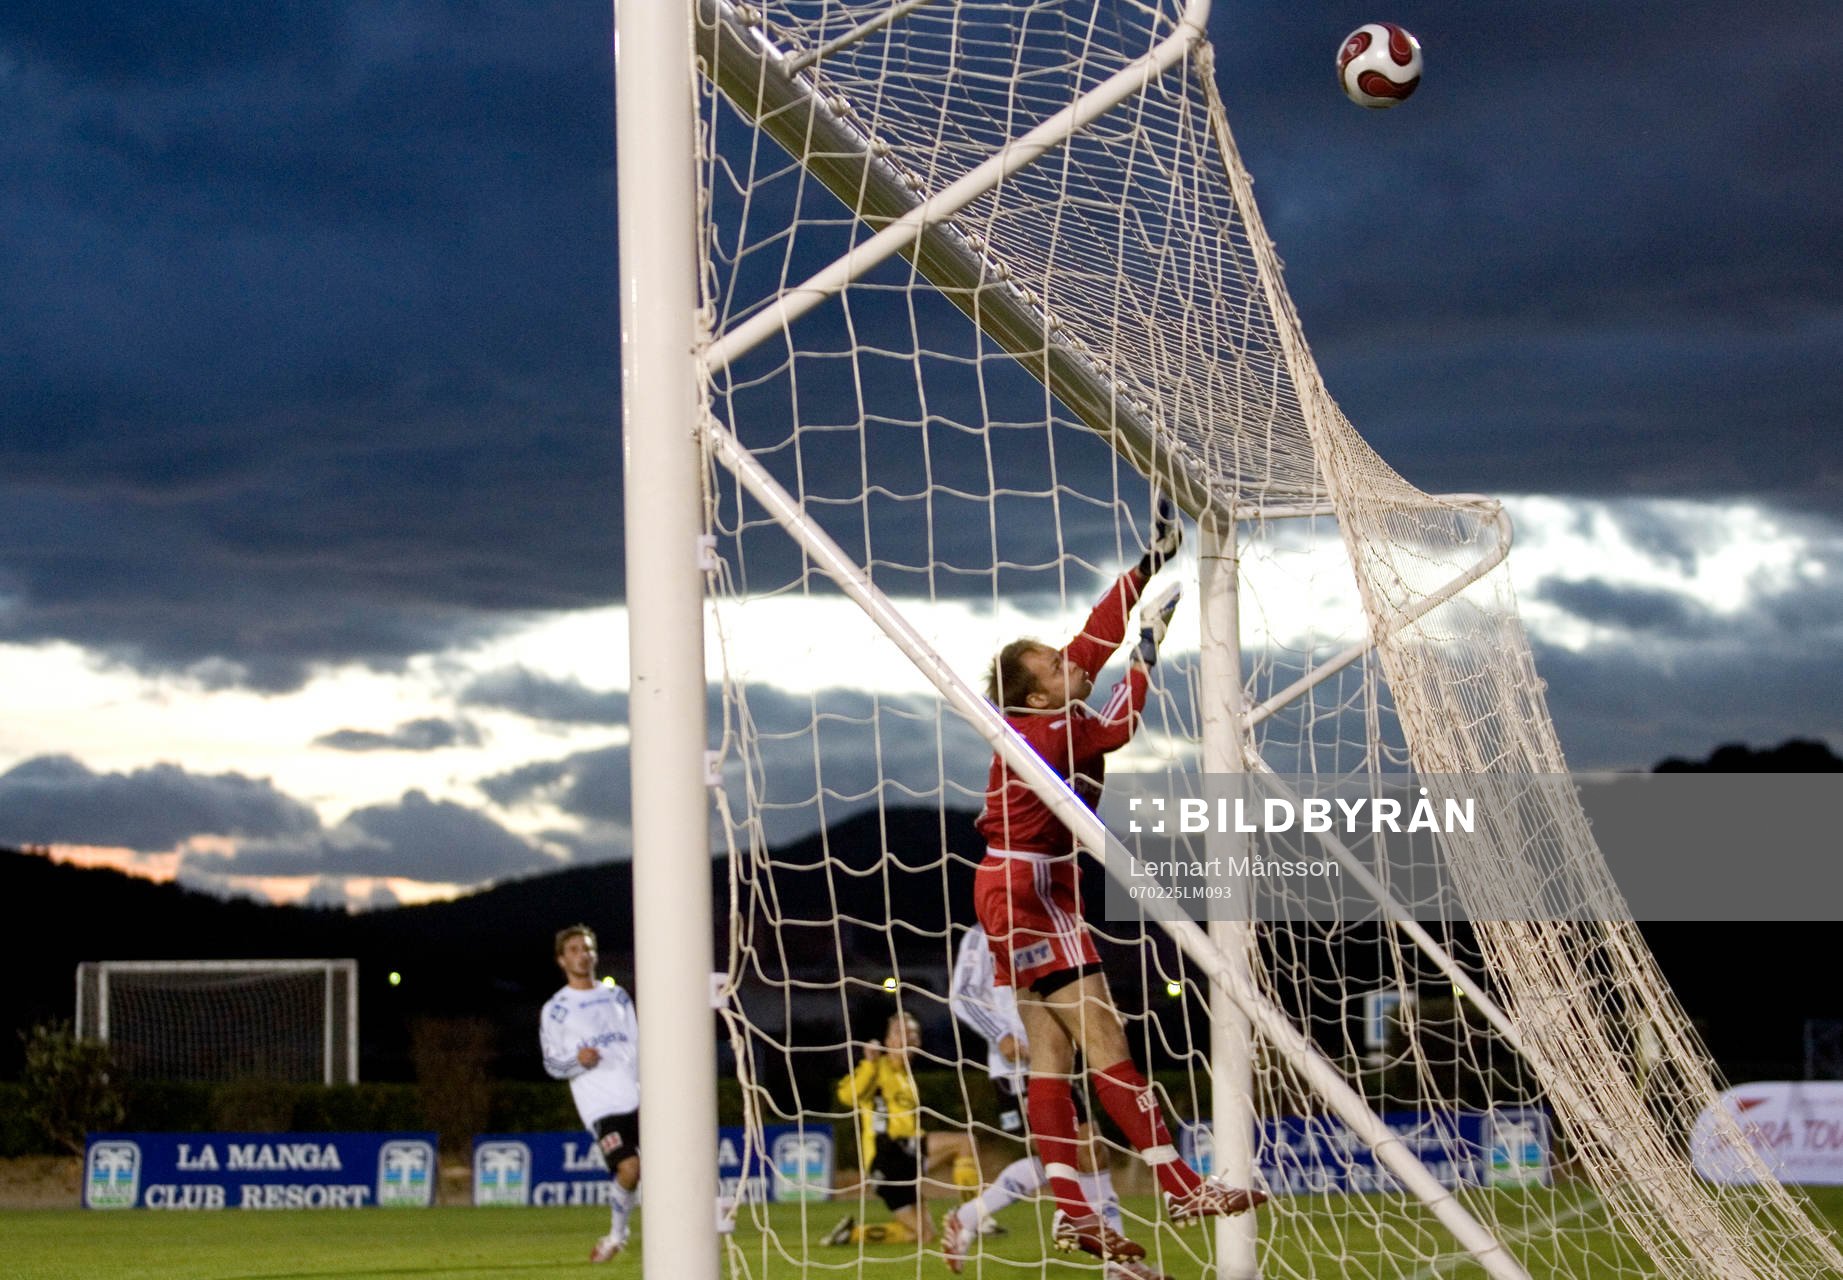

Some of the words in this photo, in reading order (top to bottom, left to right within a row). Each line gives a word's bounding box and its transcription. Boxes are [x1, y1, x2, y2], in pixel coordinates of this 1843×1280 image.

[176, 1144, 220, 1171] LA
[226, 1144, 342, 1171] MANGA
[144, 1184, 226, 1209] CLUB
[239, 1184, 370, 1209] RESORT
